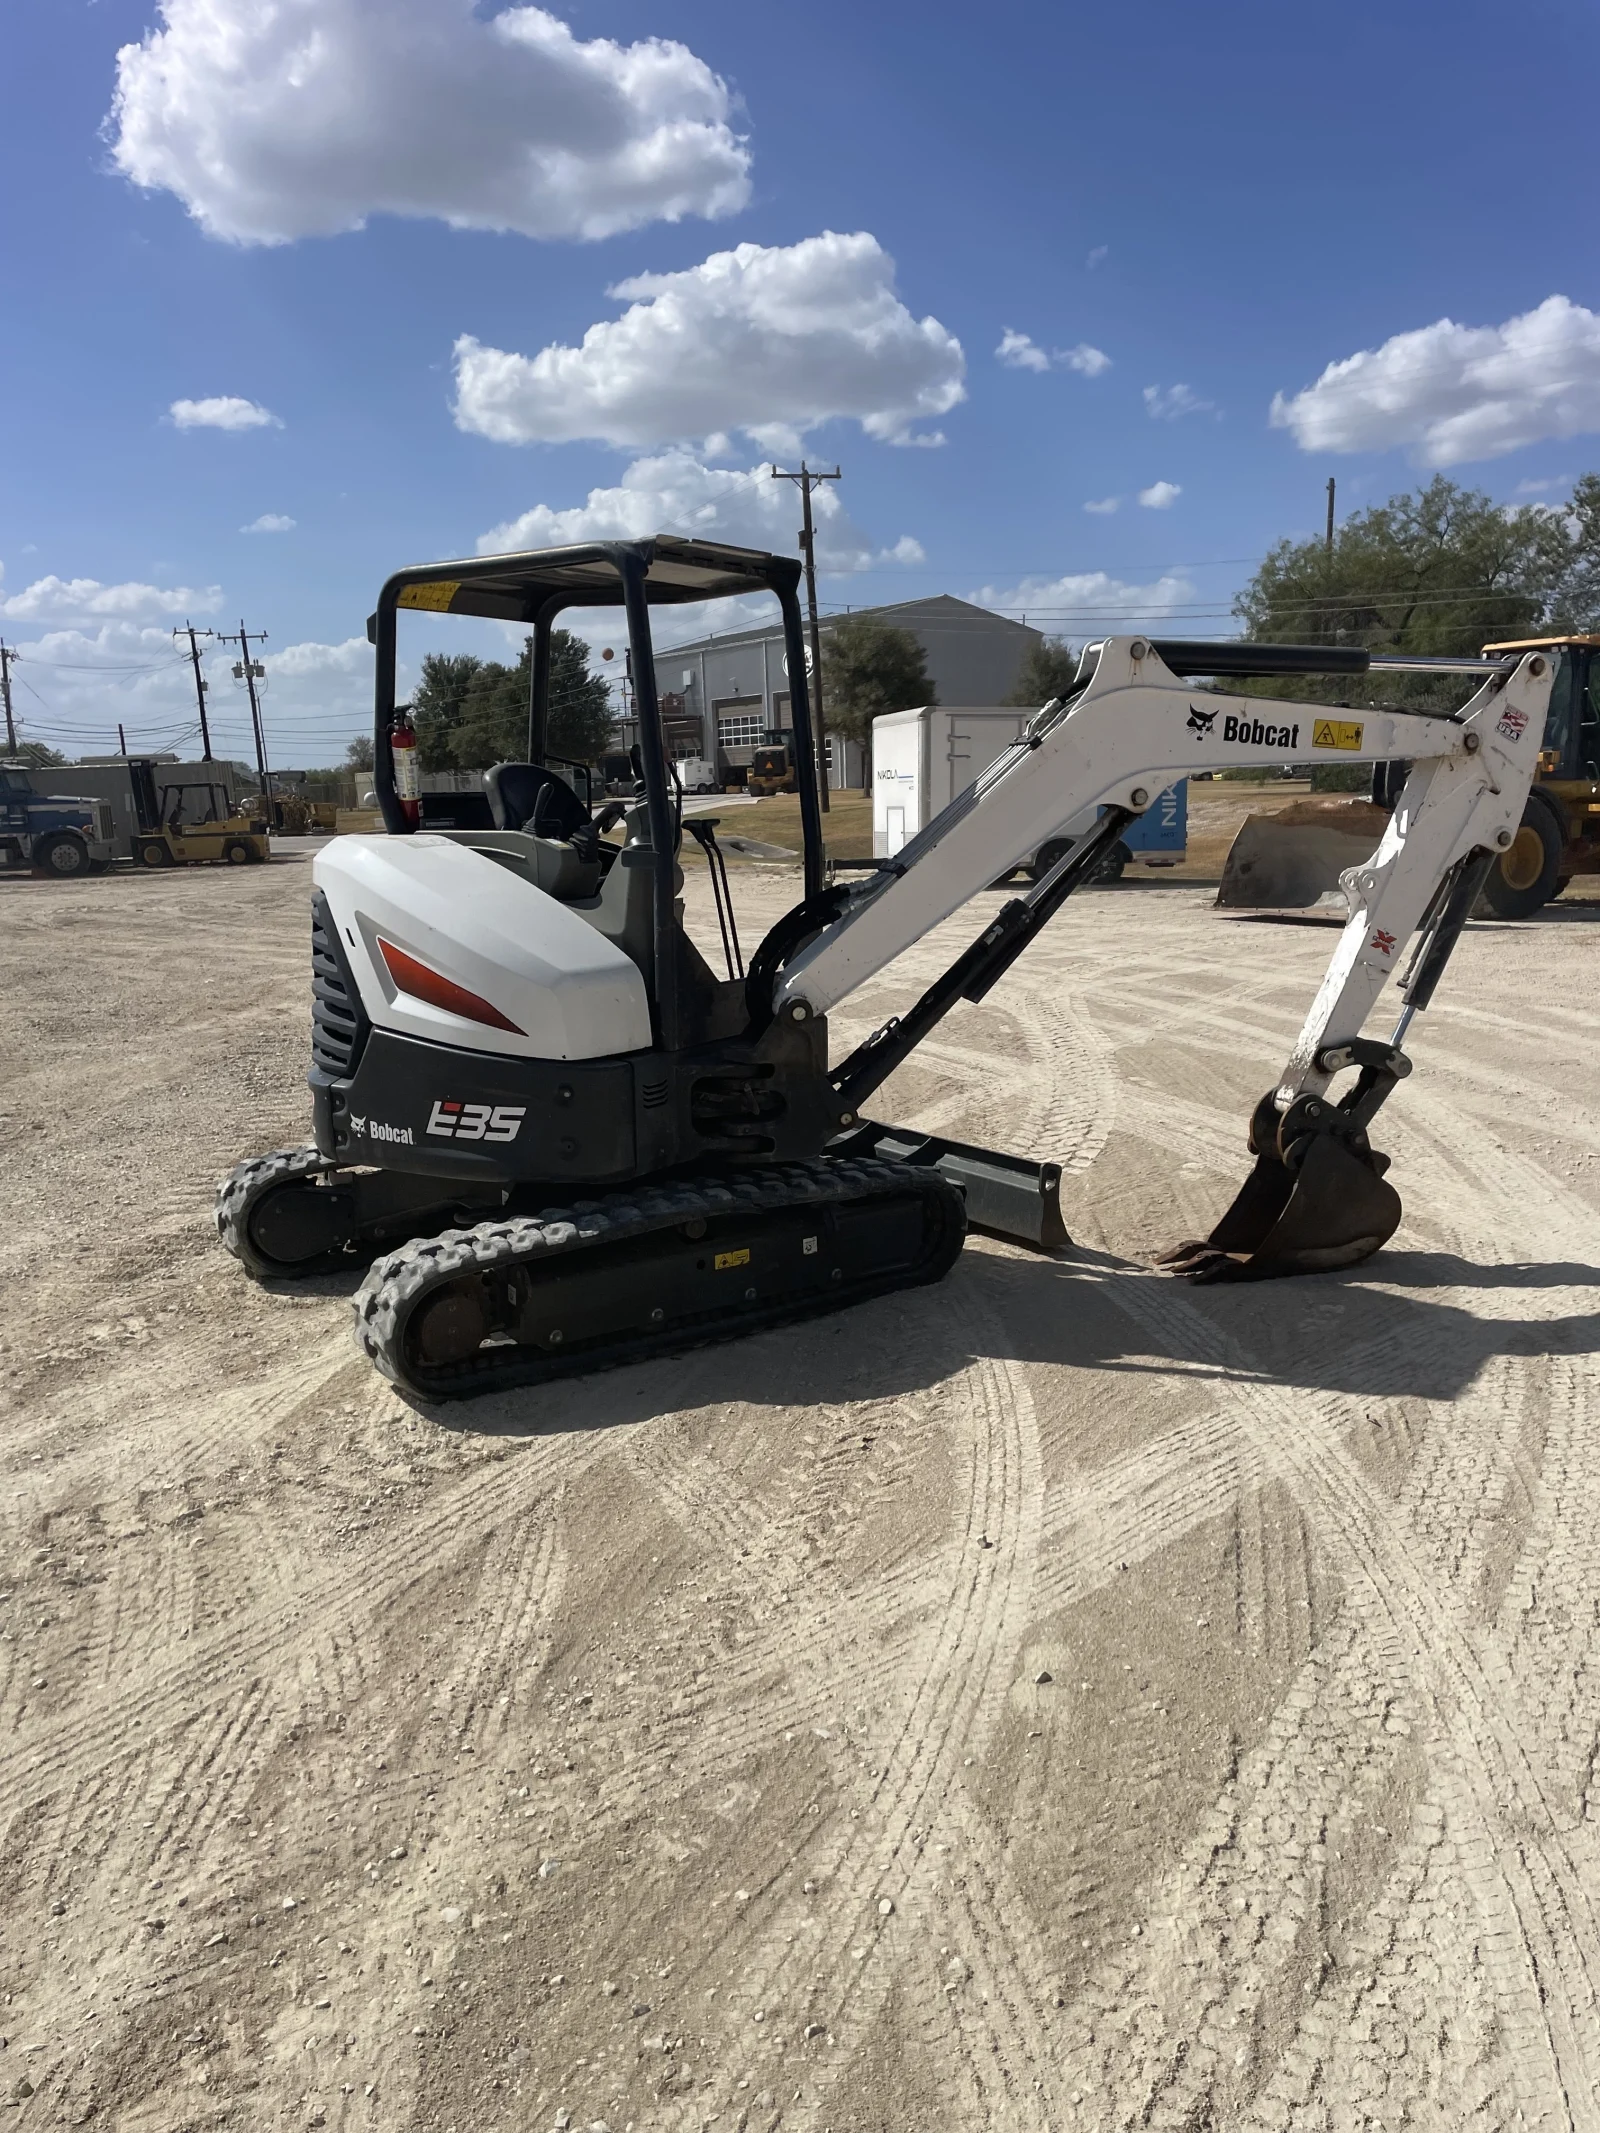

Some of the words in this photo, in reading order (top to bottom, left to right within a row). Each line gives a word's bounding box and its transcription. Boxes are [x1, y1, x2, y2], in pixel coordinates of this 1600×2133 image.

[1223, 715, 1300, 749] Bobcat
[1498, 722, 1519, 741] USA
[369, 1120, 414, 1146] Bobcat
[425, 1100, 527, 1142] E35
